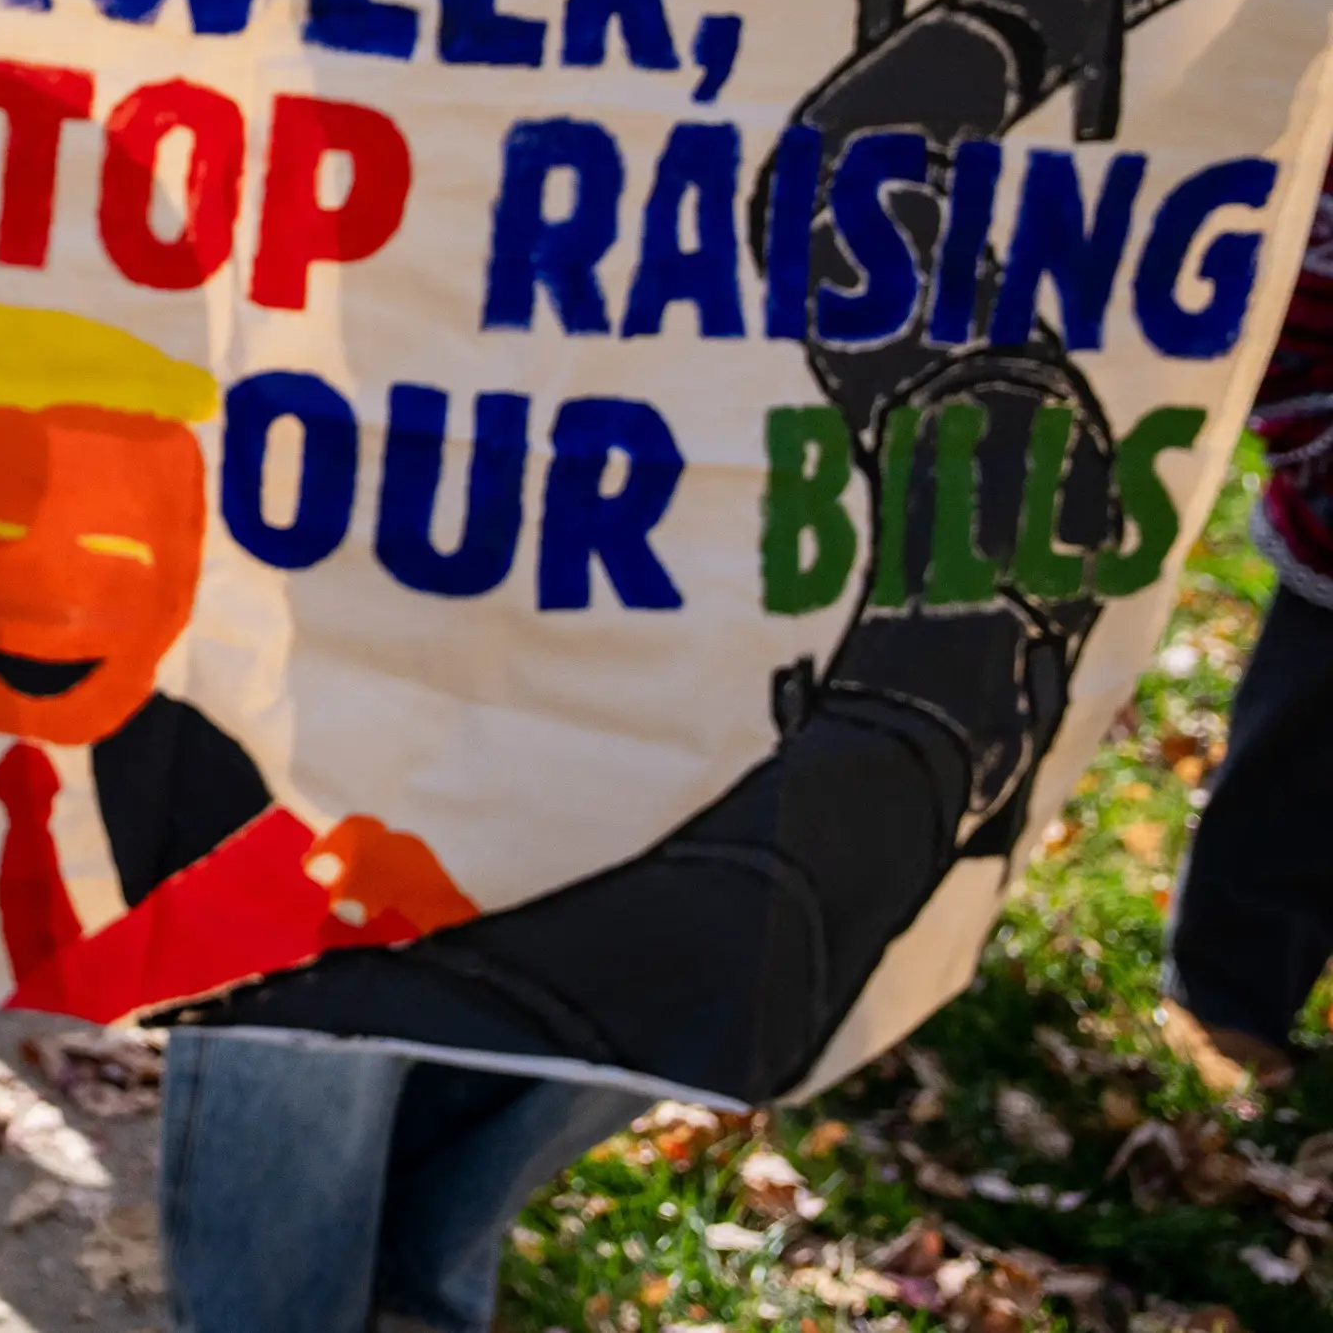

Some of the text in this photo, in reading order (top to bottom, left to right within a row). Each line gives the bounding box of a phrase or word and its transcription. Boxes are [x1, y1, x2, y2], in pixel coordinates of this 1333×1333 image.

[484, 118, 1278, 359] RAISING
[221, 371, 1205, 615] OUR BILLS
